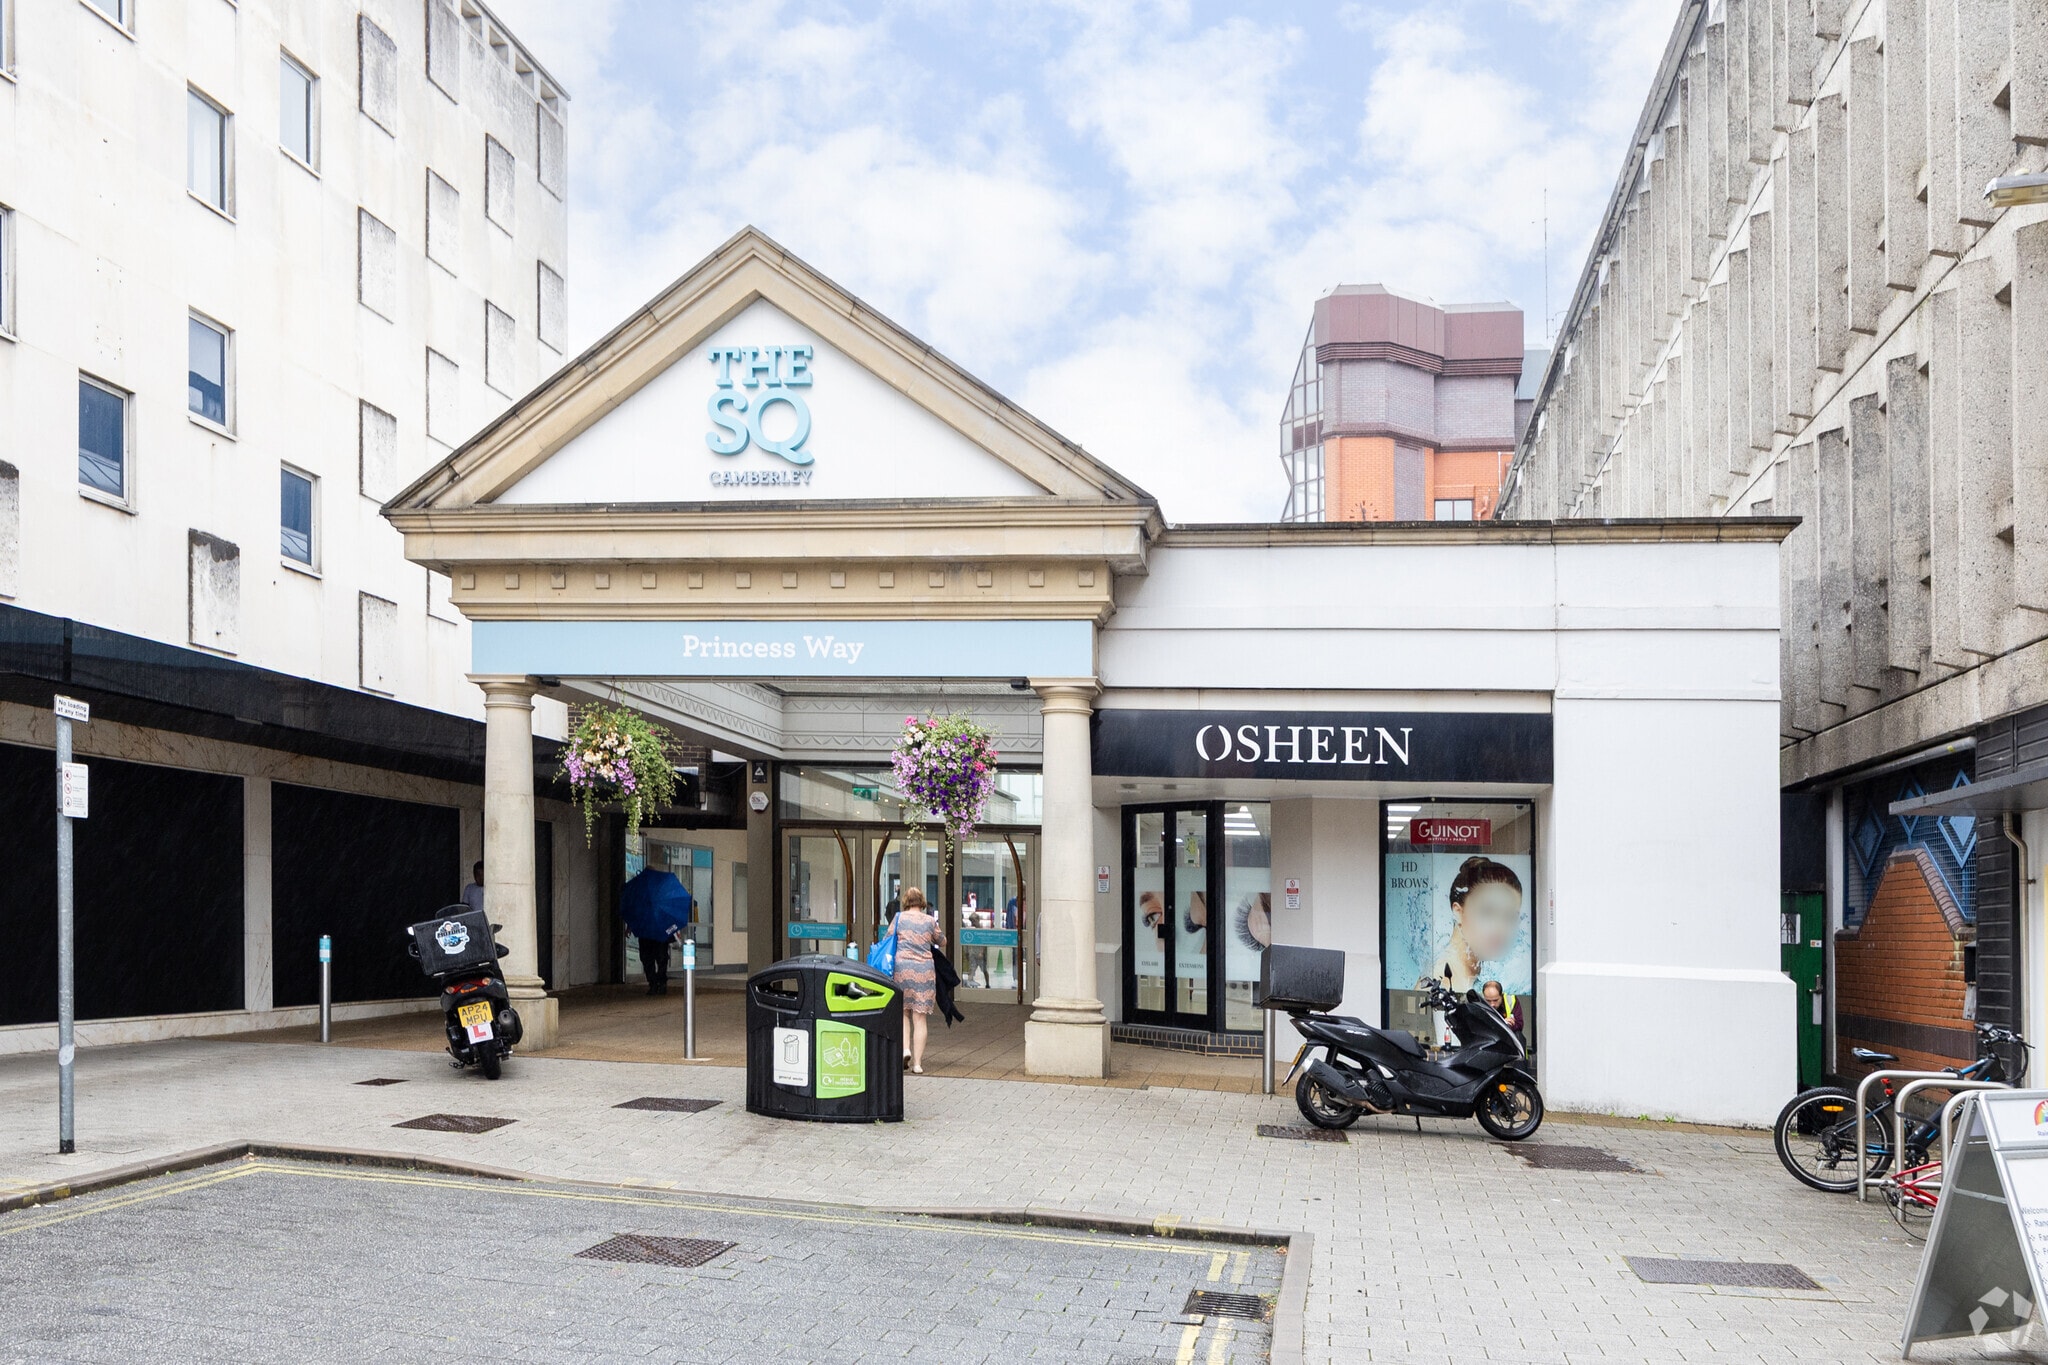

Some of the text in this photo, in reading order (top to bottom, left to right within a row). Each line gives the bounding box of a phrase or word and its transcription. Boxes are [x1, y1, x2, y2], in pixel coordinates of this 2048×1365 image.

[708, 345, 813, 387] THE
[705, 387, 815, 466] SQ
[709, 470, 813, 487] CAMBERLEY
[683, 635, 864, 665] Princess Way
[64, 709, 74, 717] any
[75, 711, 87, 719] time
[67, 701, 87, 712] loading
[1195, 724, 1413, 765] OSHEEN
[1418, 821, 1480, 838] GUINOT
[1401, 861, 1418, 872] HD
[1391, 877, 1429, 889] BROWS
[461, 1003, 488, 1017] AP24
[473, 1024, 487, 1039] L
